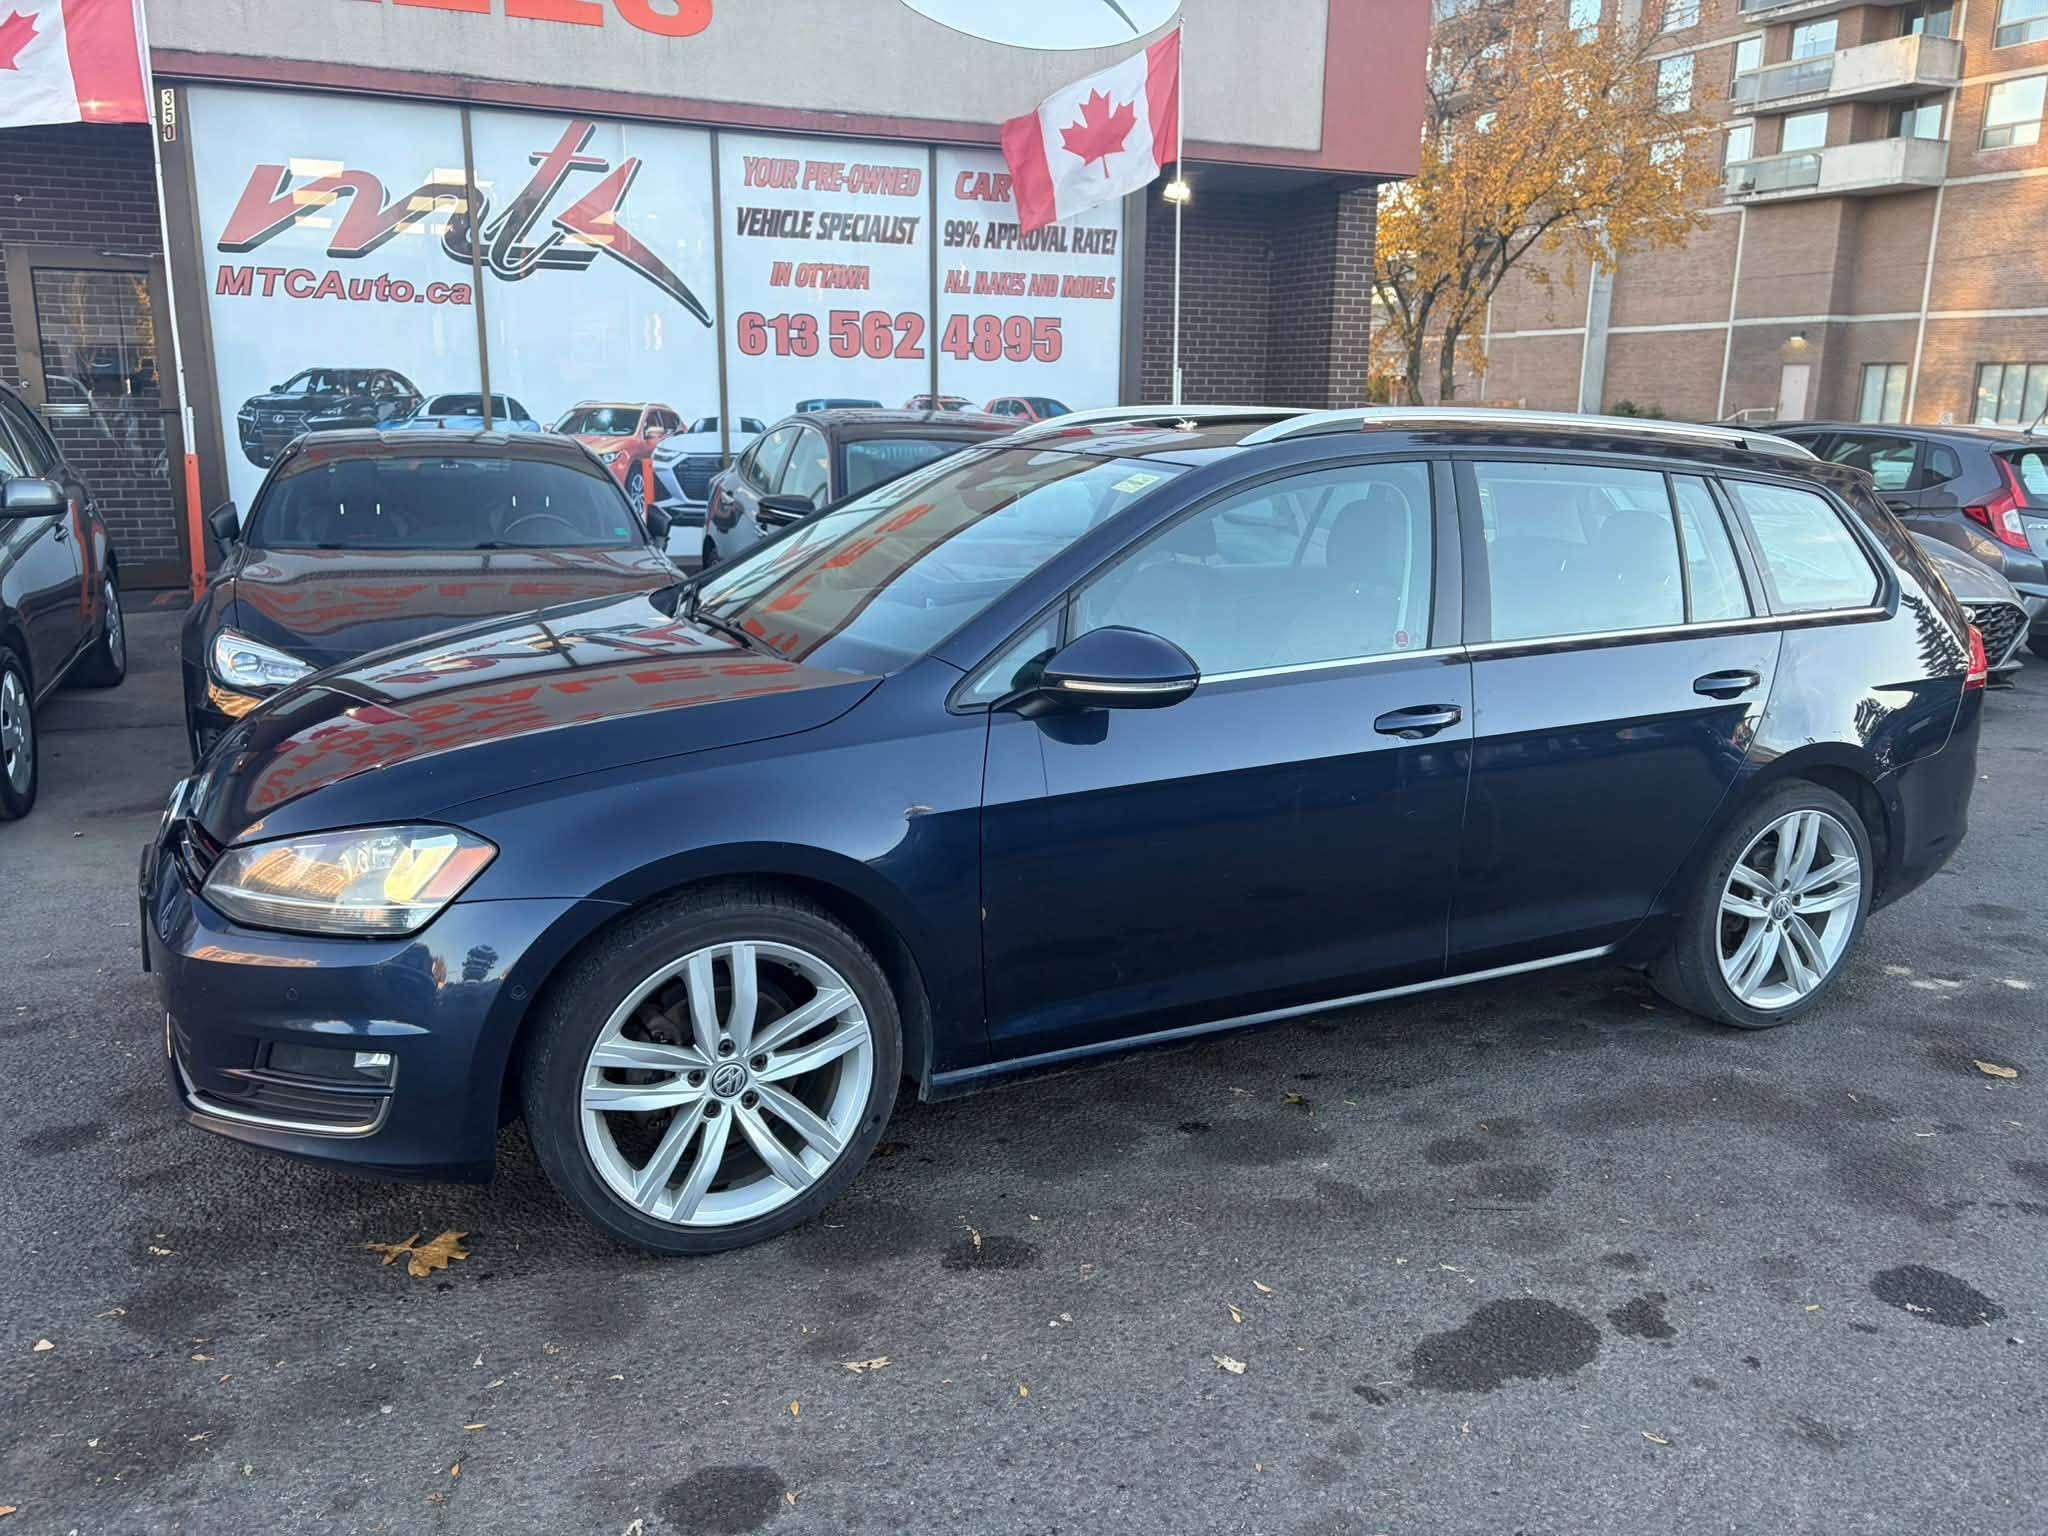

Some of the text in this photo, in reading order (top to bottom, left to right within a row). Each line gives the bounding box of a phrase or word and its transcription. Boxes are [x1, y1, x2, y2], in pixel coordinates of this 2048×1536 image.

[164, 90, 174, 140] 350
[743, 156, 921, 197] YOUR PRE-OWNED
[955, 171, 1012, 202] CAR
[737, 207, 920, 244] VEHICLE SPECIALIST
[944, 220, 980, 248] 99%
[1072, 227, 1118, 255] RATE!
[216, 266, 472, 304] MTCAuto.ca
[770, 262, 870, 289] IN OTTAWA
[944, 270, 1116, 299] ALL MAKES AND MODELS
[737, 310, 1063, 362] 613 562 4895
